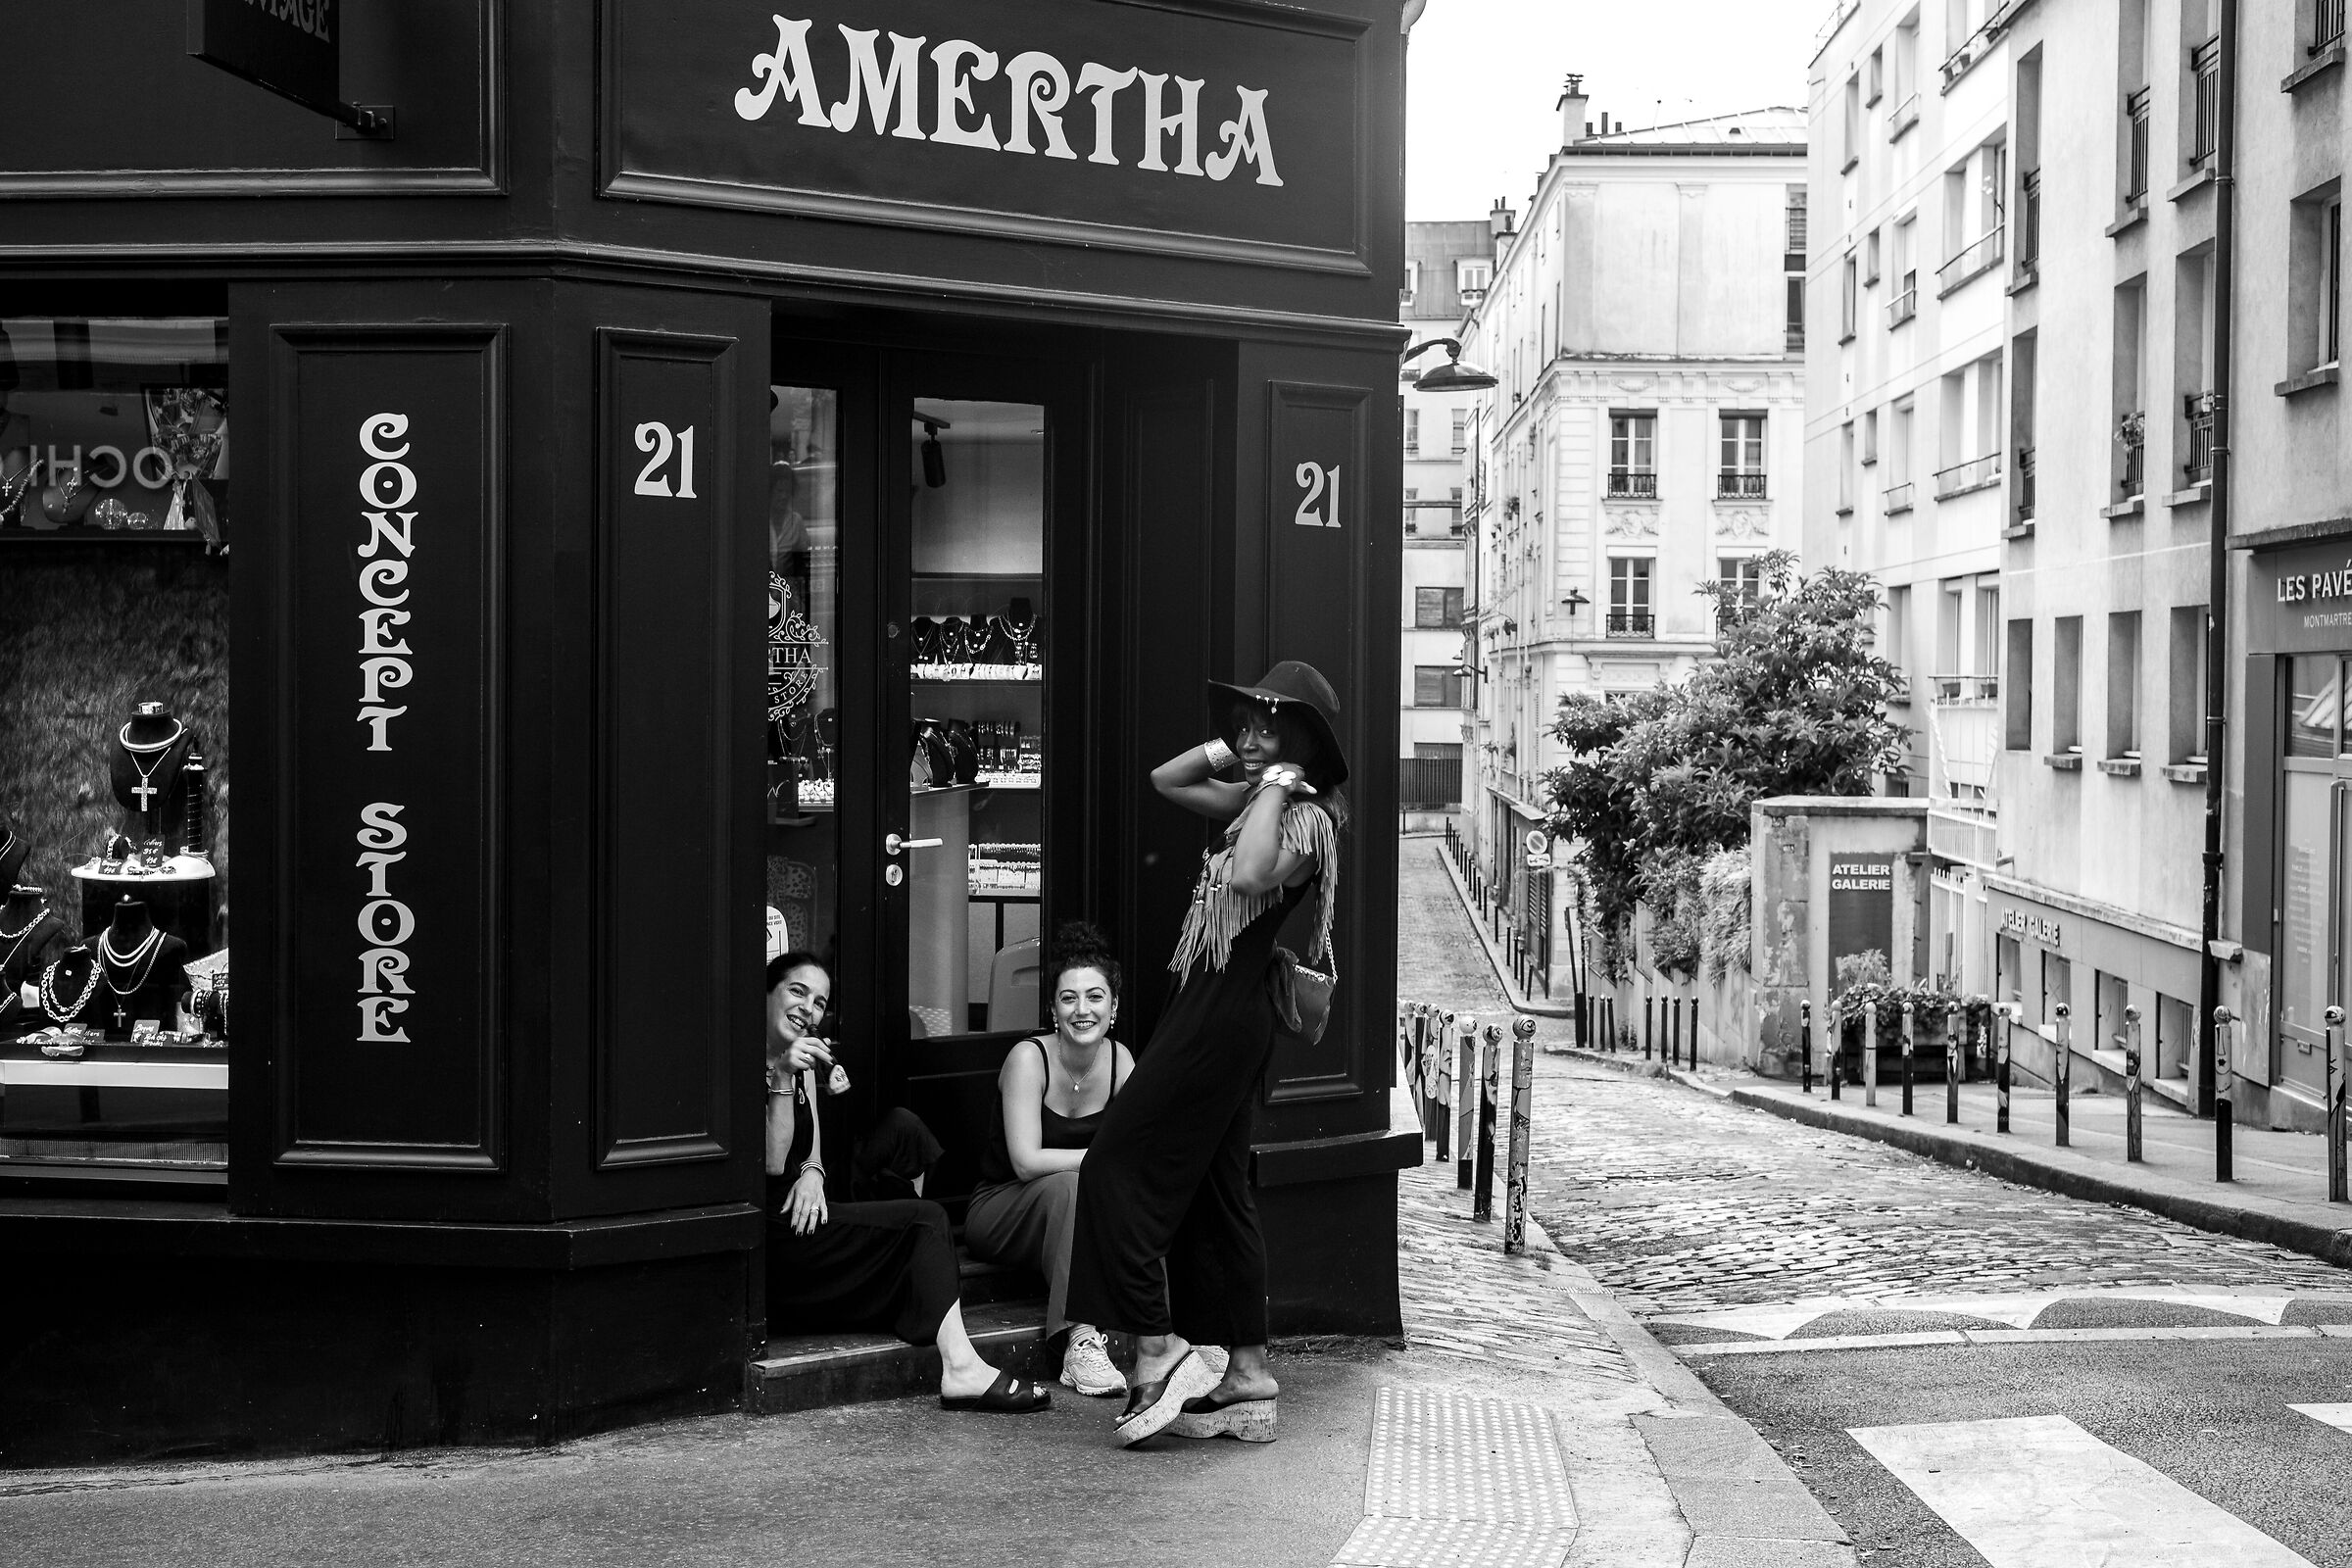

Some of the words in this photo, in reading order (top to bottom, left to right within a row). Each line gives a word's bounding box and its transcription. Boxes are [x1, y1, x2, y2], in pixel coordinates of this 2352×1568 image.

[734, 13, 1285, 187] AMERTHA
[634, 421, 697, 499] 21
[1295, 461, 1342, 528] 21
[357, 413, 418, 753] CONCEPT
[2278, 575, 2306, 603] LES
[2312, 559, 2352, 599] PAVÉ
[2304, 612, 2352, 628] MONTMARTRE
[774, 672, 808, 704] STORE
[1832, 863, 1890, 875] ATELIER
[1832, 878, 1890, 891] GALERIE
[356, 802, 416, 1045] STORE
[2001, 906, 2027, 934] ATELIER
[2030, 916, 2061, 948] GALERIE
